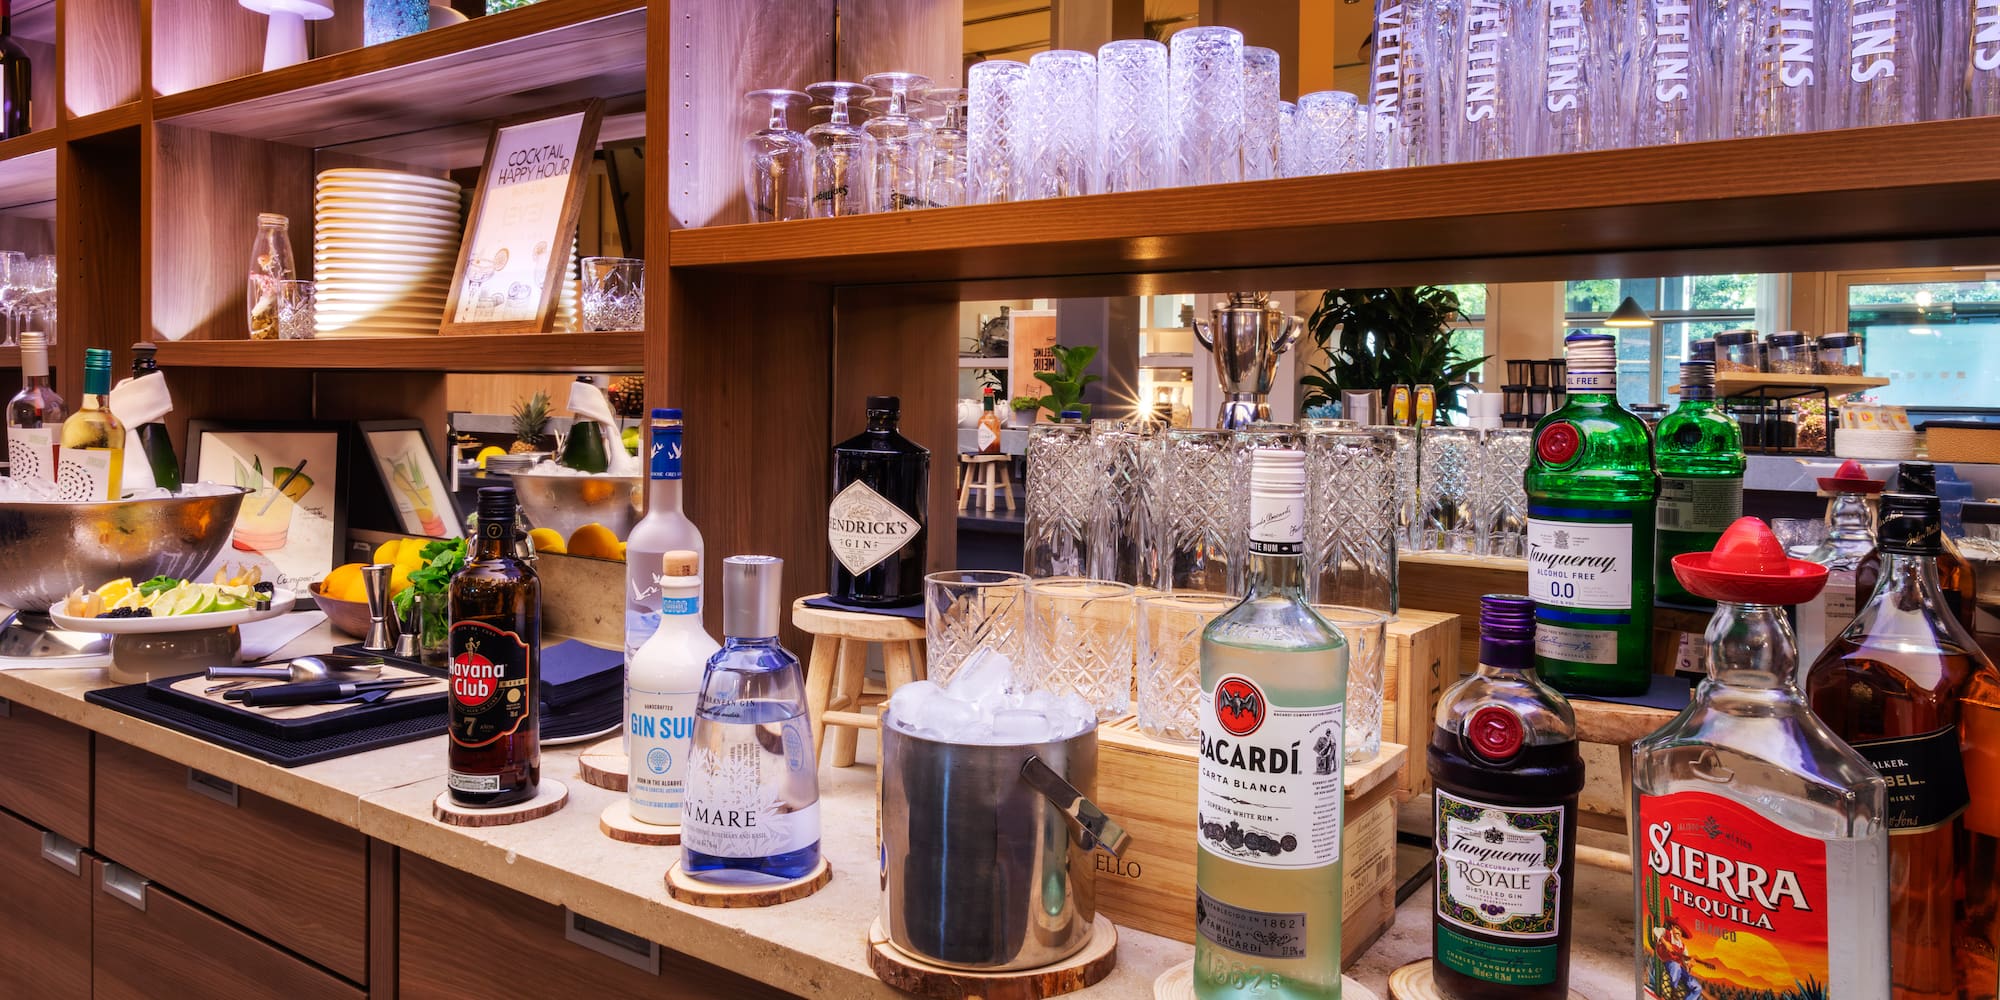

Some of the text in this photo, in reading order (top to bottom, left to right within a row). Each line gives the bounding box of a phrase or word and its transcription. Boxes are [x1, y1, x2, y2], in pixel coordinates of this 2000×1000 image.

[1655, 0, 1690, 103] LTINS
[1375, 4, 1402, 132] VELTINS
[508, 144, 564, 167] COCKTAIL
[498, 158, 570, 185] HAPPY HOUR
[1576, 377, 1599, 385] FREE
[845, 538, 872, 549] GIN
[1263, 543, 1278, 553] RUM
[1530, 543, 1616, 573] Tanqueray
[1537, 568, 1596, 580] ALCOHOL FREE
[1551, 581, 1574, 599] 0.0
[449, 657, 505, 678] Havana
[454, 678, 489, 697] Club
[463, 716, 477, 736] 7
[631, 712, 655, 738] GIN
[1200, 729, 1301, 775] BACARDÍ
[1202, 767, 1287, 794] CARTA BLANCA
[1884, 774, 1920, 787] BEL
[695, 805, 757, 828] MARE
[1207, 800, 1273, 822] SUPERIOR WHITE RUM
[1452, 834, 1542, 867] Tanqueray
[1456, 860, 1531, 890] ROYALE
[1468, 859, 1520, 872] BLACKCURRANT
[1648, 820, 1812, 912] SIERRA
[1465, 885, 1505, 898] DISTILLED
[1668, 882, 1776, 932] TEQUILA
[1207, 918, 1242, 939] FAMILIA
[1263, 919, 1296, 929] 1862
[1695, 918, 1737, 943] BLANCO
